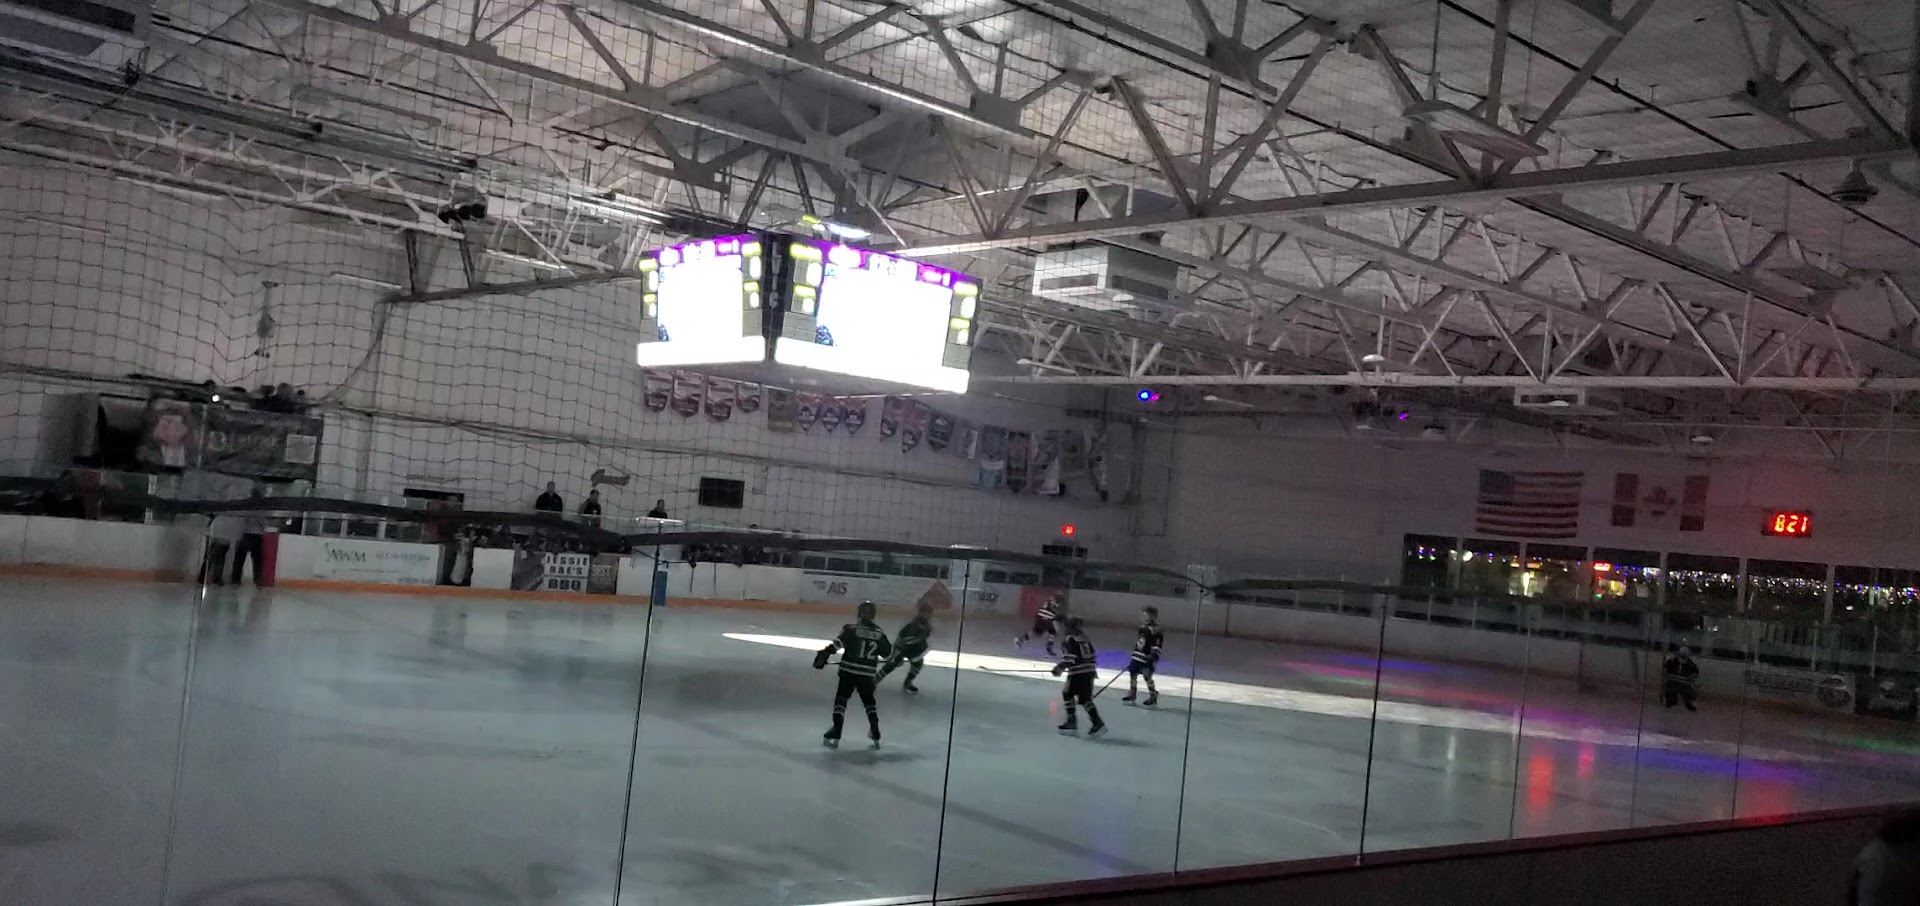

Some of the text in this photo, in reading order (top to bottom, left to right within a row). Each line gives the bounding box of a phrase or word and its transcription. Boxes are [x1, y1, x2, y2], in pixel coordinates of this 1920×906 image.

[546, 555, 588, 565] JESSIE
[549, 566, 583, 575] RAE'S
[859, 640, 878, 660] 12
